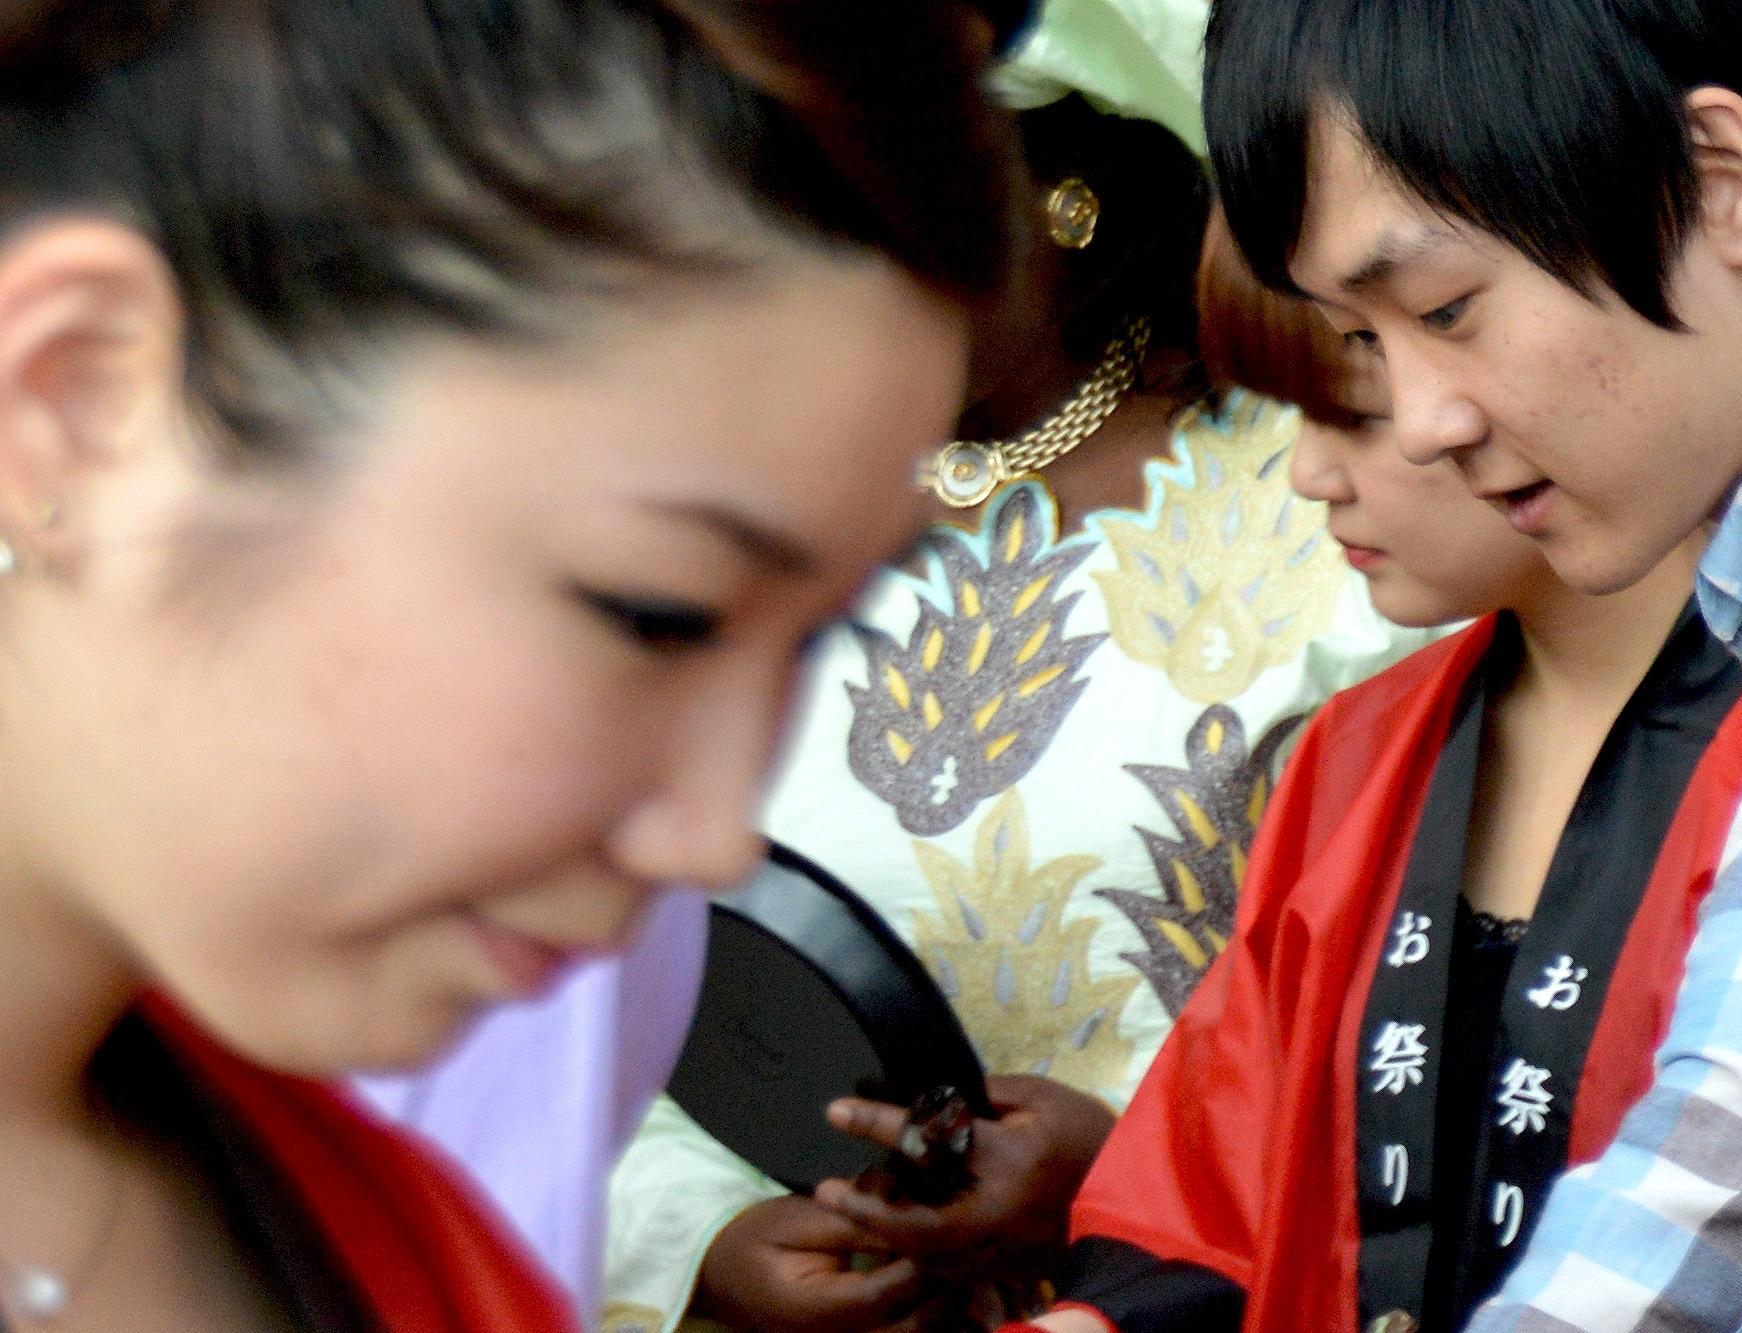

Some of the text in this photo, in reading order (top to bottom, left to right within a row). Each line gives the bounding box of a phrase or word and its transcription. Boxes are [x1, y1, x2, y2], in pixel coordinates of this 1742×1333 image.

[1370, 911, 1432, 1206] お祭り
[1492, 955, 1589, 1248] お祭り
